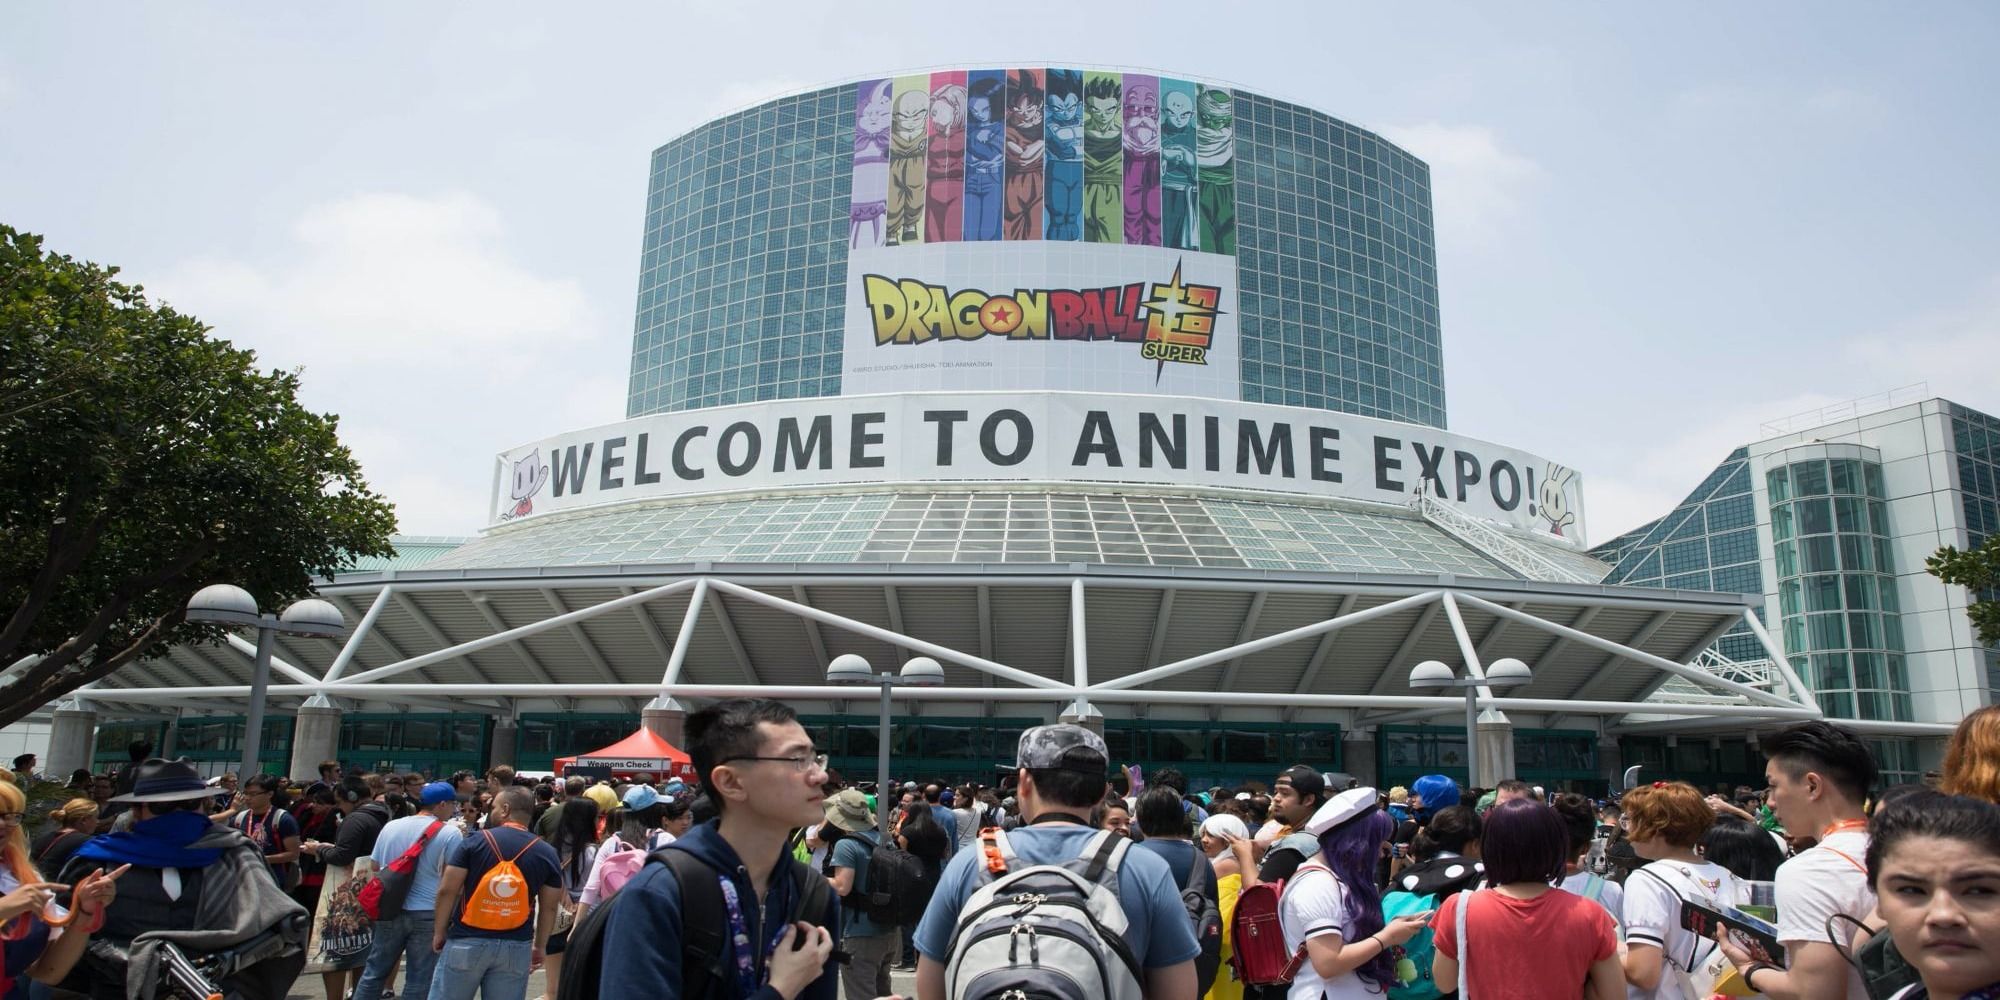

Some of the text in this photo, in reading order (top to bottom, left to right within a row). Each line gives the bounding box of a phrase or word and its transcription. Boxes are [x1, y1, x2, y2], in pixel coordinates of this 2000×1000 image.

[862, 274, 1147, 347] DRAGON BALL
[1141, 342, 1208, 366] SUPER
[551, 409, 1537, 518] WELCOME TO ANIME EXPO!
[587, 760, 653, 768] Weapons Check
